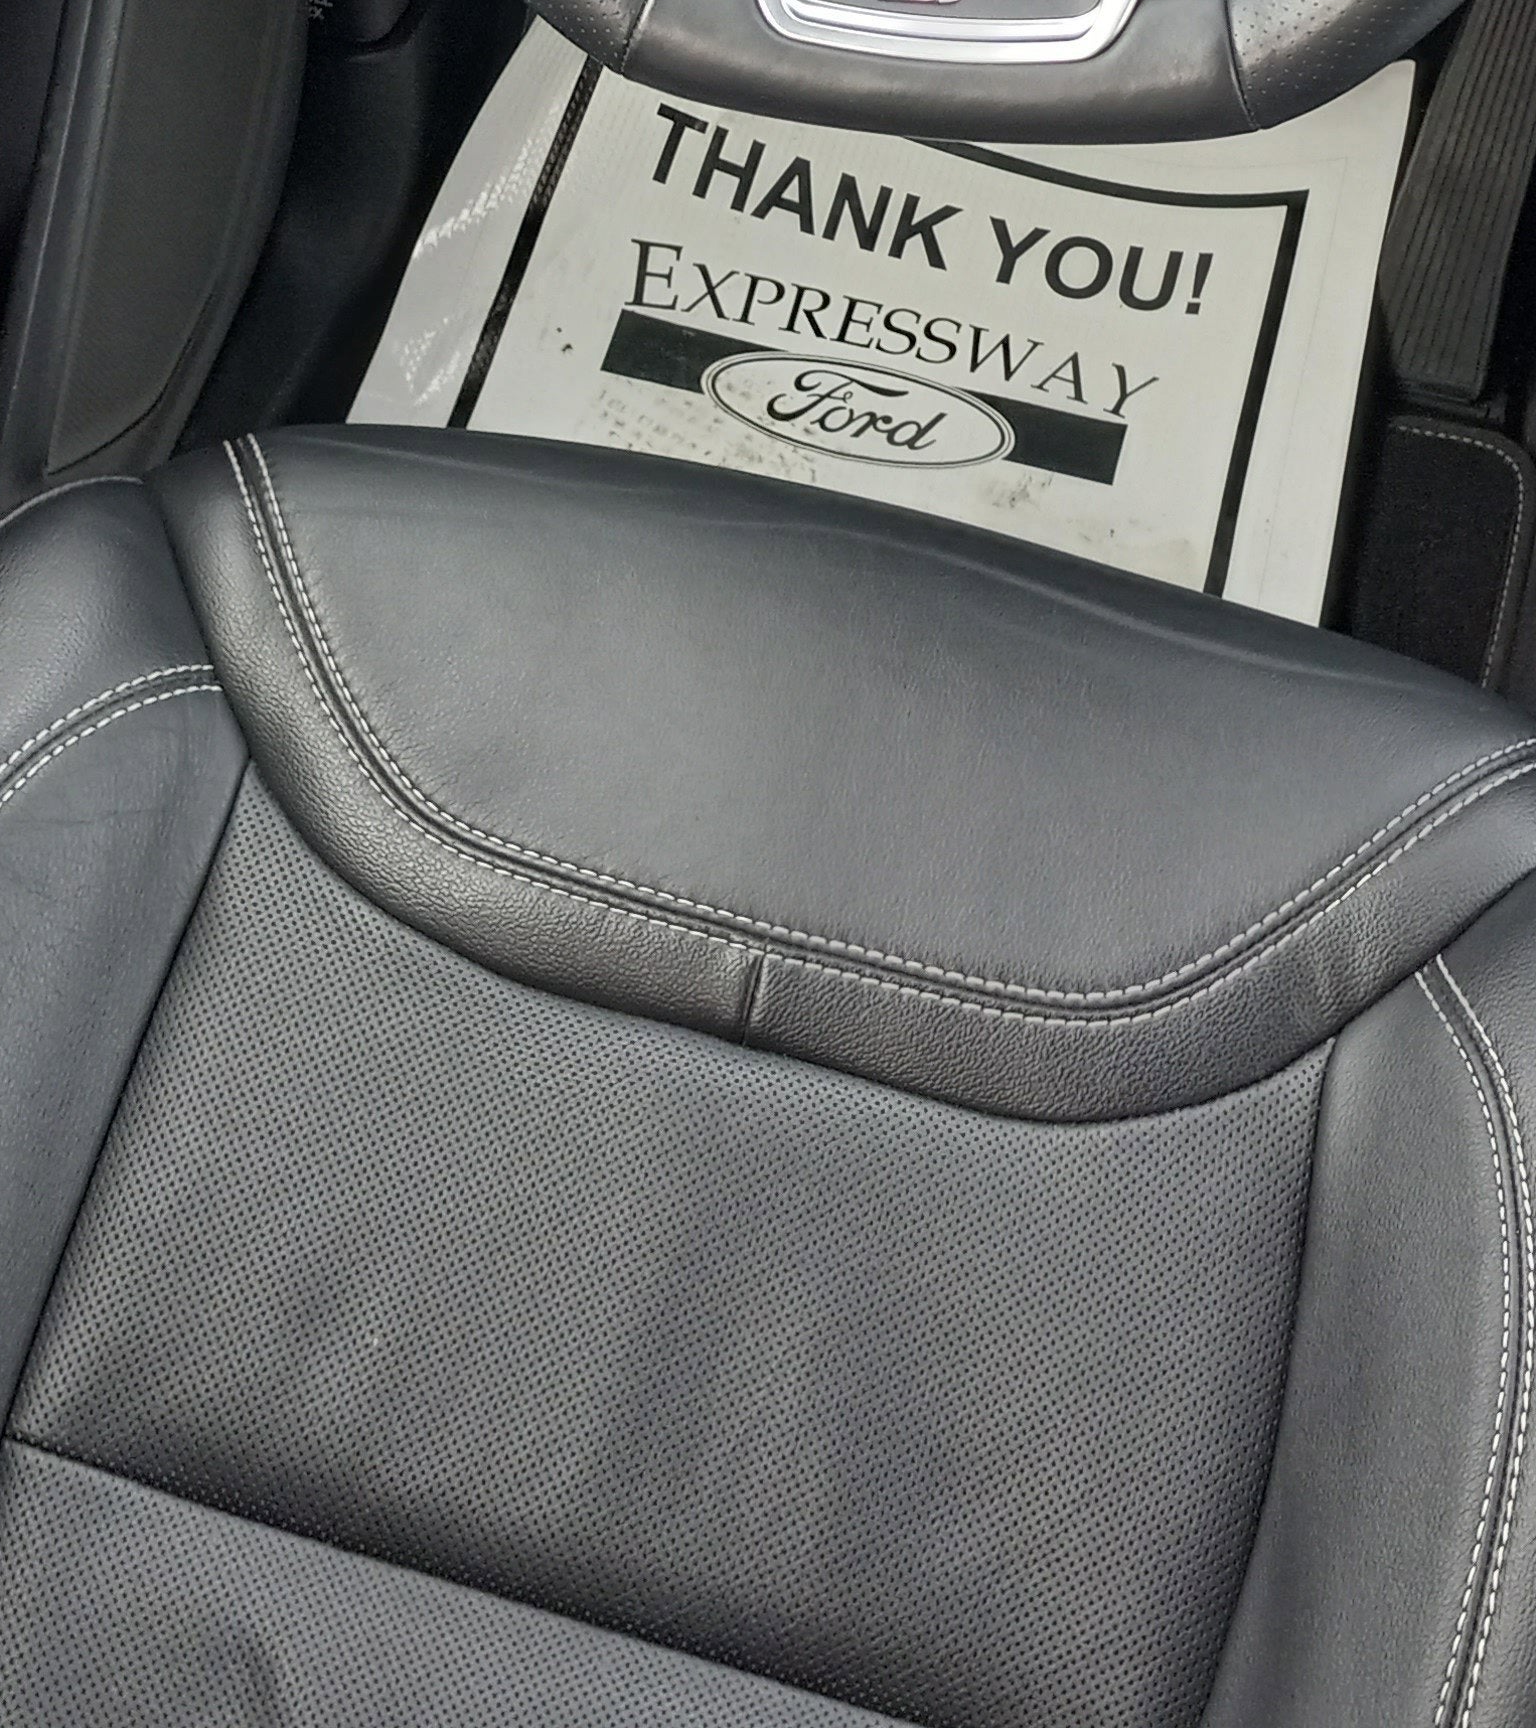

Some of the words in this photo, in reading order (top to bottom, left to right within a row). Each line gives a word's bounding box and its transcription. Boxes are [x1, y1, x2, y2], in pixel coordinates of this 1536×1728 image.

[651, 102, 965, 272] THANK
[988, 215, 1215, 316] YOU!
[765, 369, 948, 451] Ford
